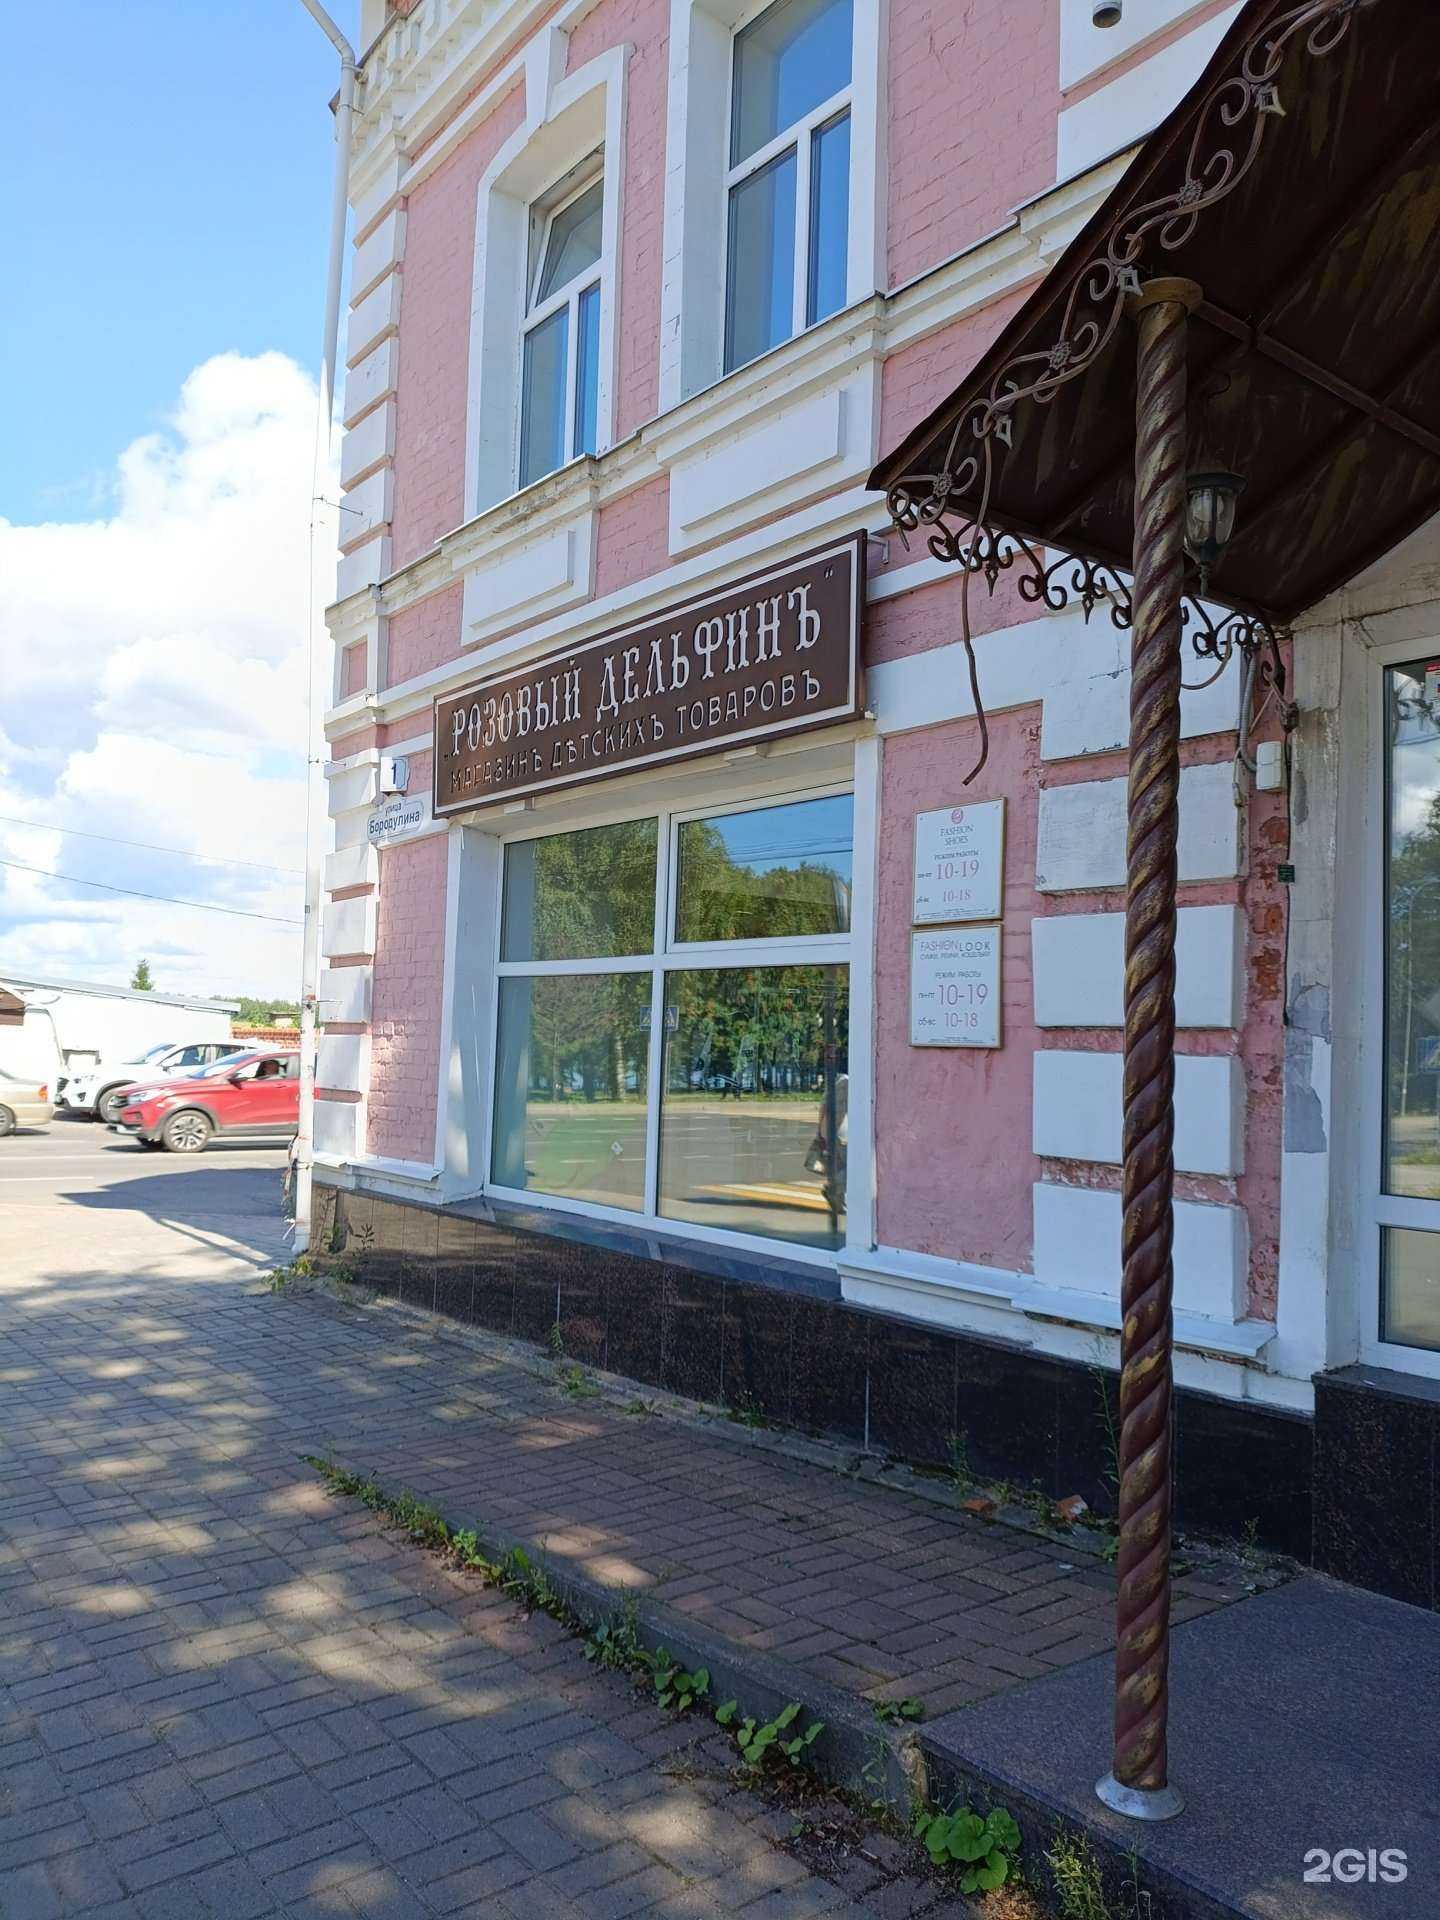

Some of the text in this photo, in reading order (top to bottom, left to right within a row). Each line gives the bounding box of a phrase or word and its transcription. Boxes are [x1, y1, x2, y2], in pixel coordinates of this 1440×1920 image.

[451, 748, 543, 793] МАГАЗИНЪ
[676, 669, 821, 735] ТОВАРОВЪ
[391, 763, 397, 784] 1
[369, 809, 421, 835] Бородулина
[940, 824, 974, 837] FASHION
[936, 859, 980, 880] 10-19
[939, 983, 988, 1006] 10-19
[944, 1012, 978, 1028] 10-18
